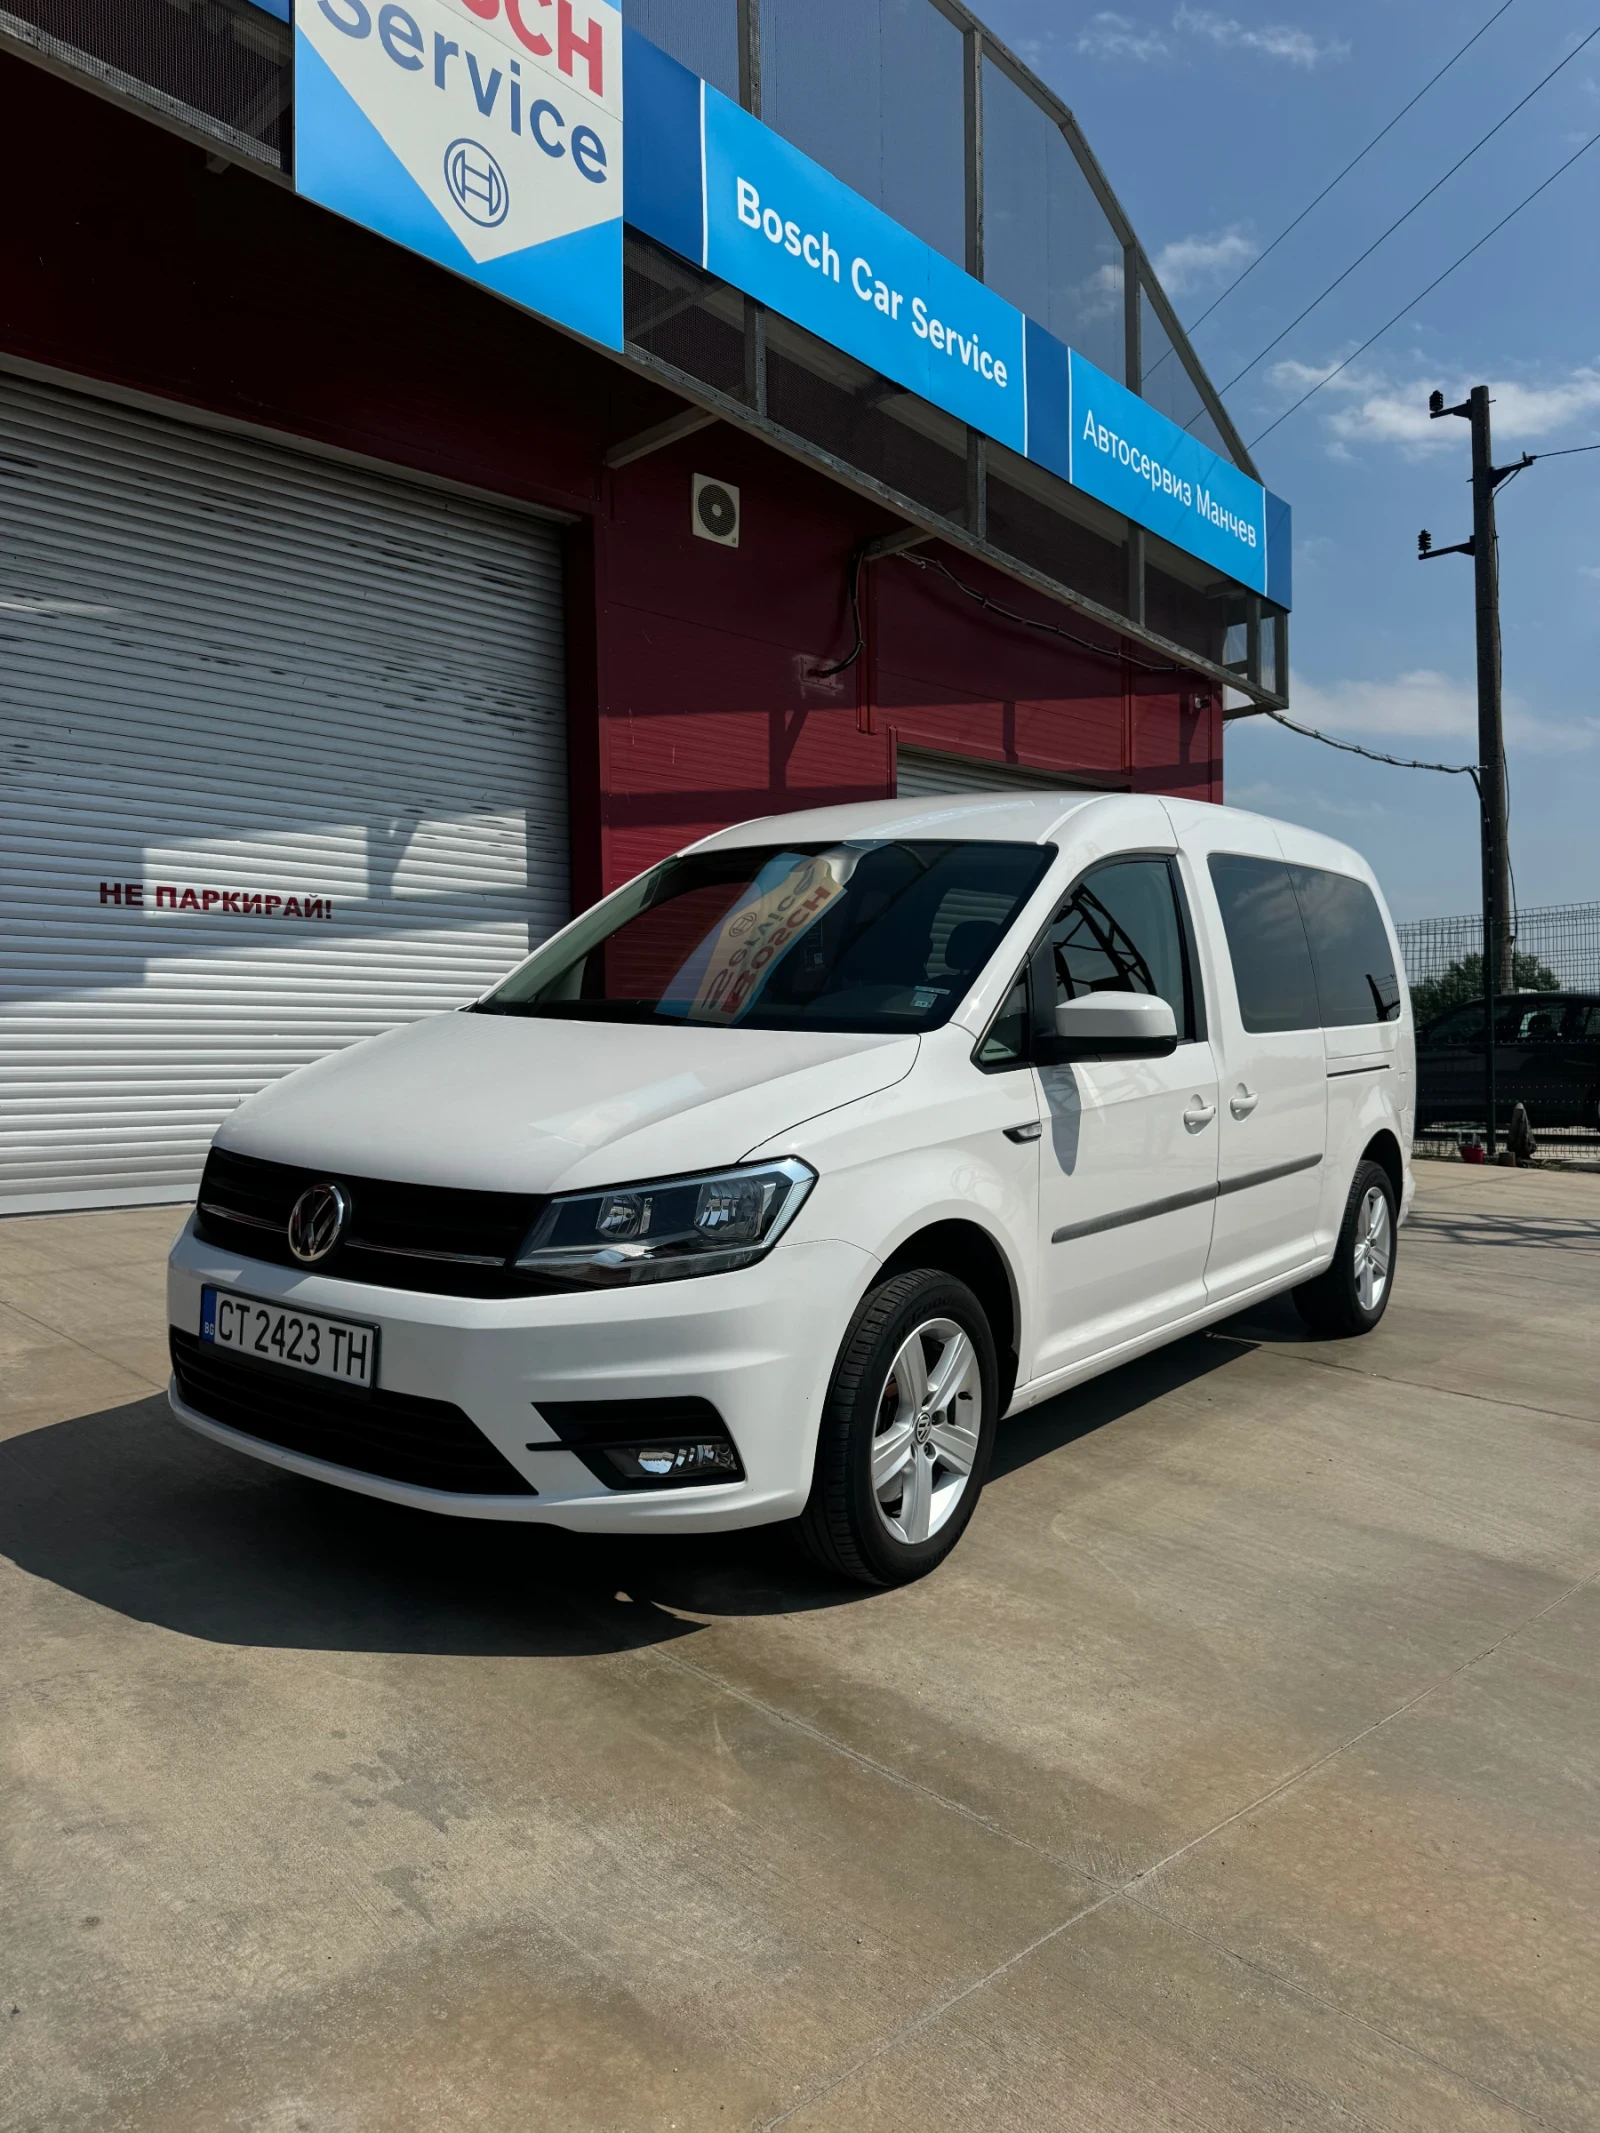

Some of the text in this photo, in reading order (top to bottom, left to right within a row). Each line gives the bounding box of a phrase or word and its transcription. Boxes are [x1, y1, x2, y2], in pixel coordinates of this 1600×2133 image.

[737, 176, 1008, 388] Bosch Car Service
[1083, 409, 1257, 548] Автосервиз Манчев
[100, 882, 332, 919] НЕ ПАРКИРАЙ!
[204, 1321, 215, 1336] BG
[218, 1300, 367, 1379] CT 2423 TH
